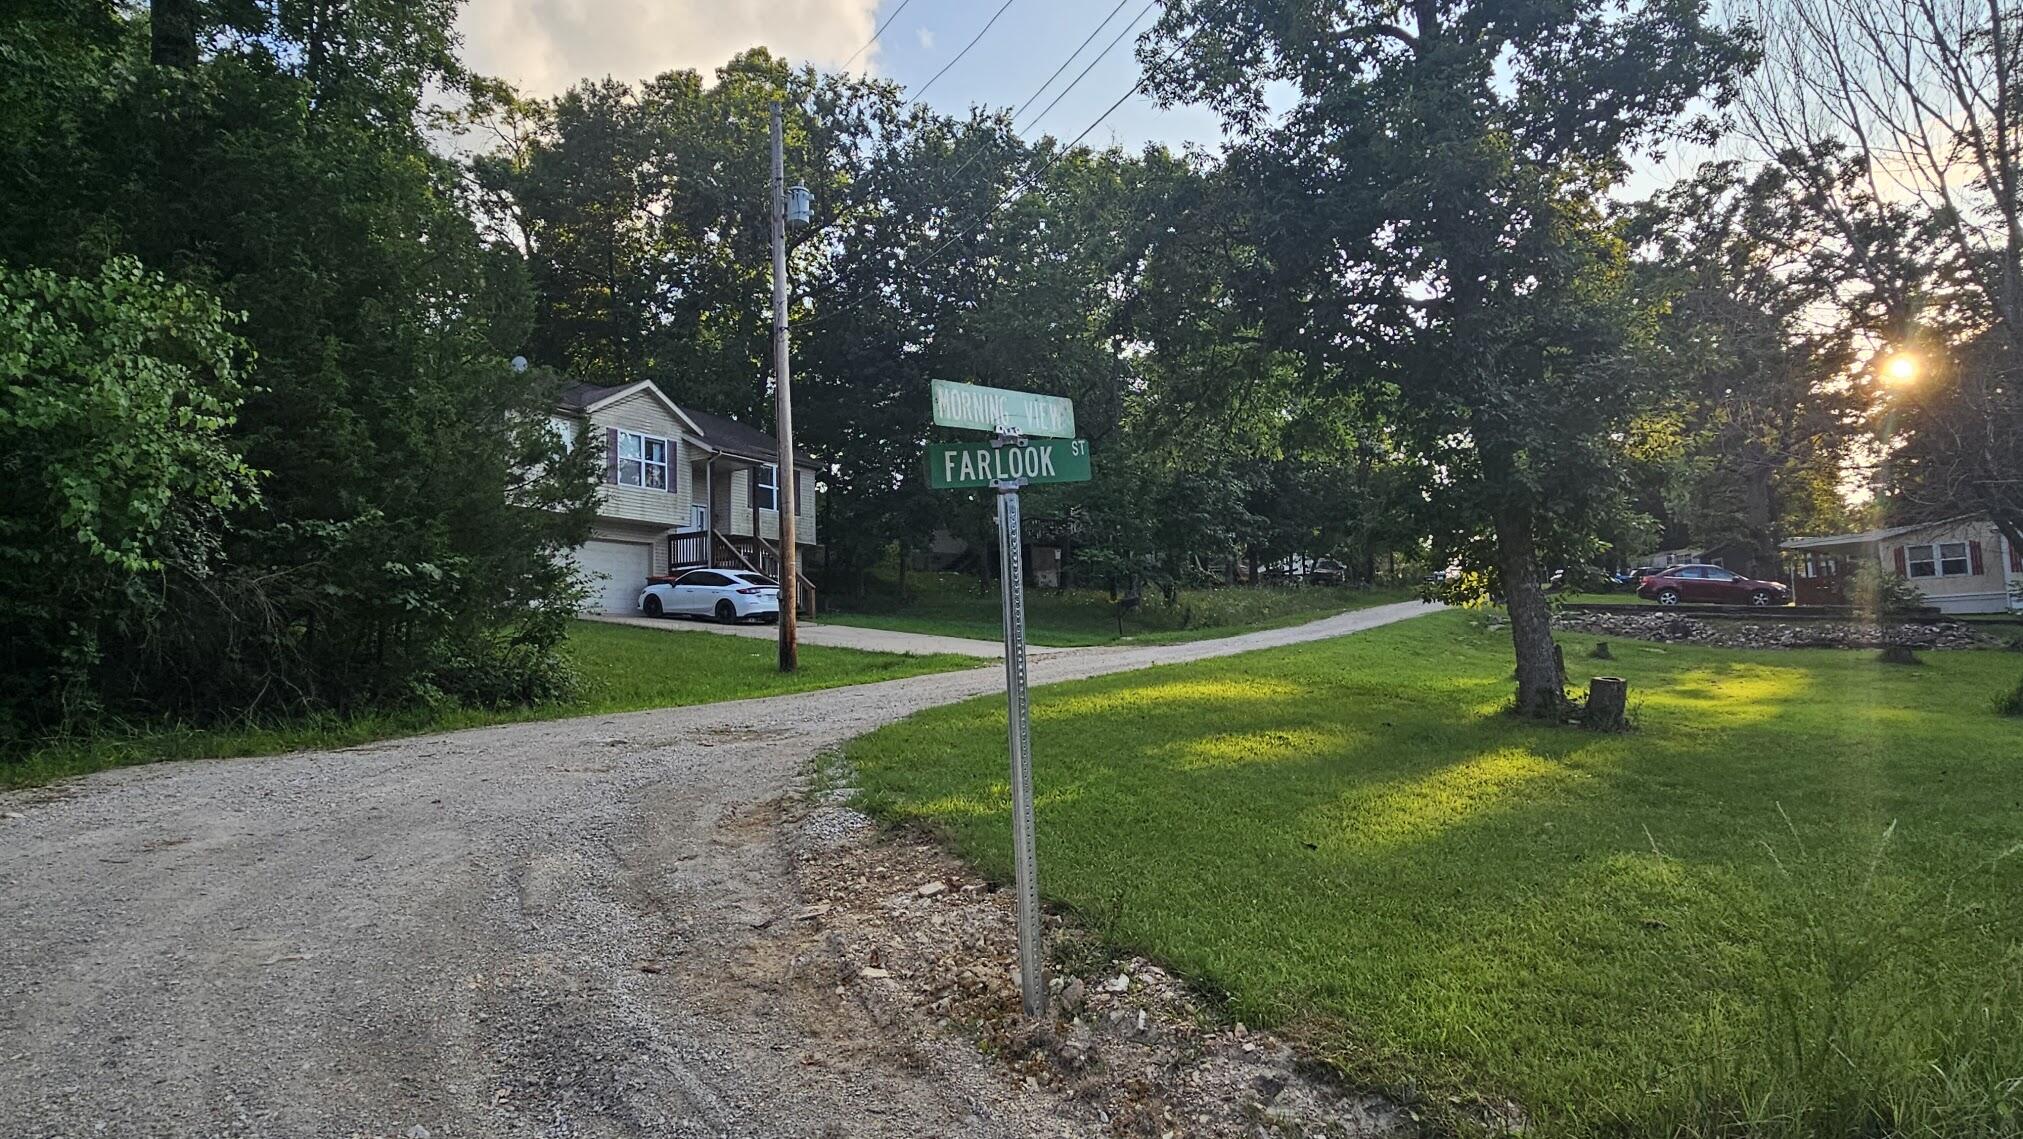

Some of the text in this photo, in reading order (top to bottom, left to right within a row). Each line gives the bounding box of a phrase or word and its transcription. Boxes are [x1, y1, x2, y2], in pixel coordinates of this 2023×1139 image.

[938, 388, 1064, 431] MORNING VIEW
[944, 440, 1086, 482] FARLOOK ST
